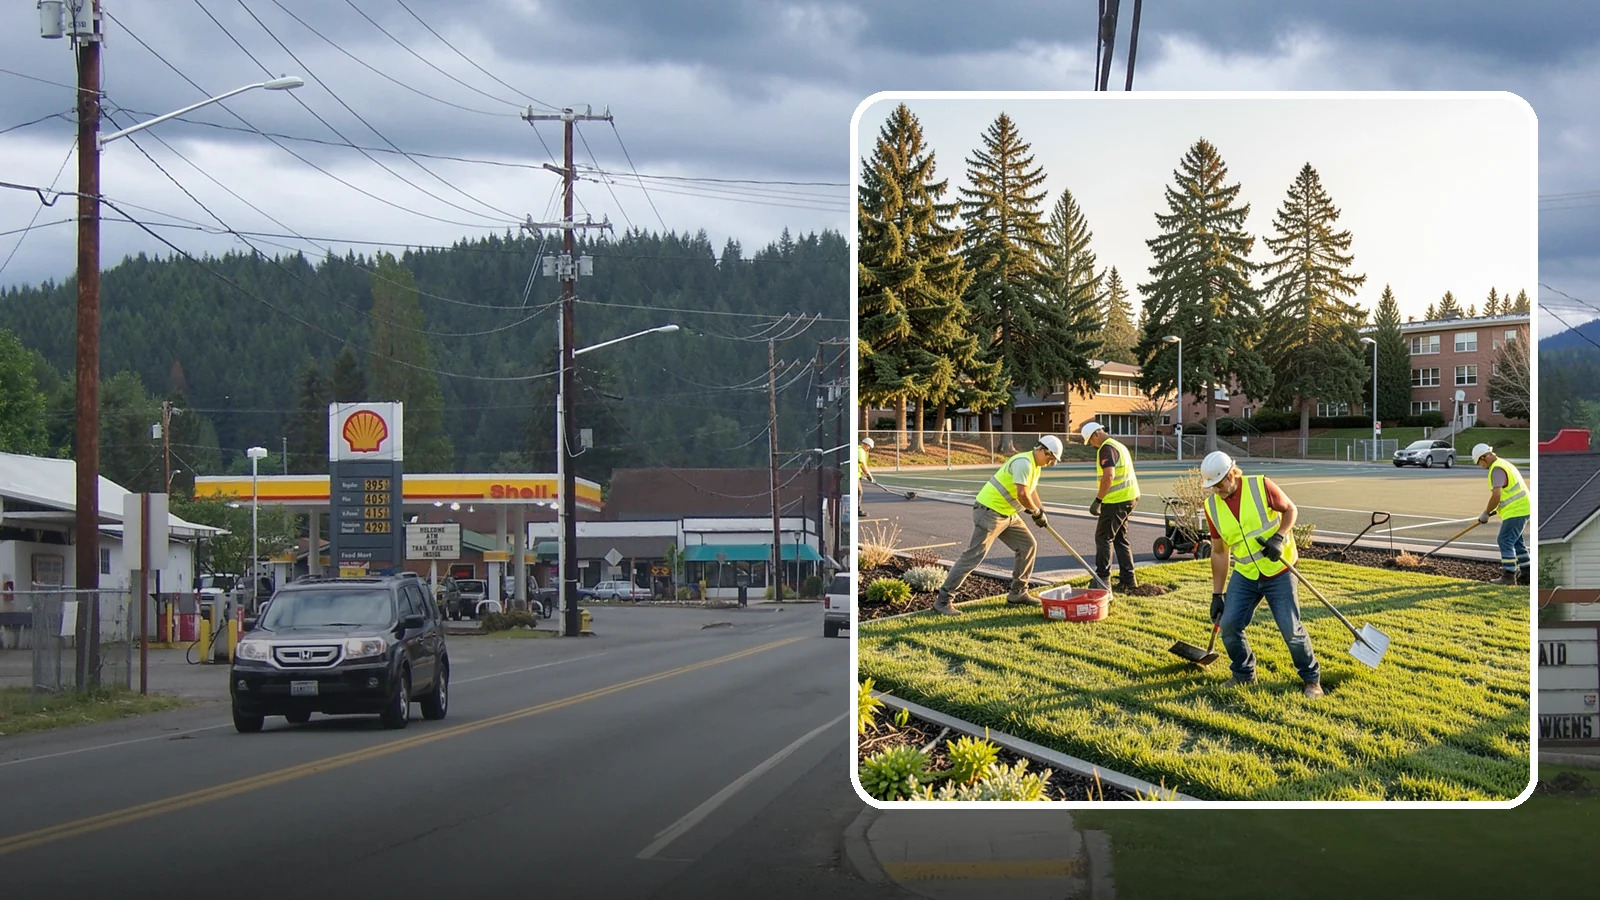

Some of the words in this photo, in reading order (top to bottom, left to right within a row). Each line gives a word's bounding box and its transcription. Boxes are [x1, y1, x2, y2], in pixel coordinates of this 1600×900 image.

[365, 480, 383, 490] 395
[490, 484, 547, 499] Shell
[365, 494, 383, 504] 405
[365, 508, 383, 518] 415
[365, 522, 383, 532] 429
[1538, 643, 1567, 666] AID
